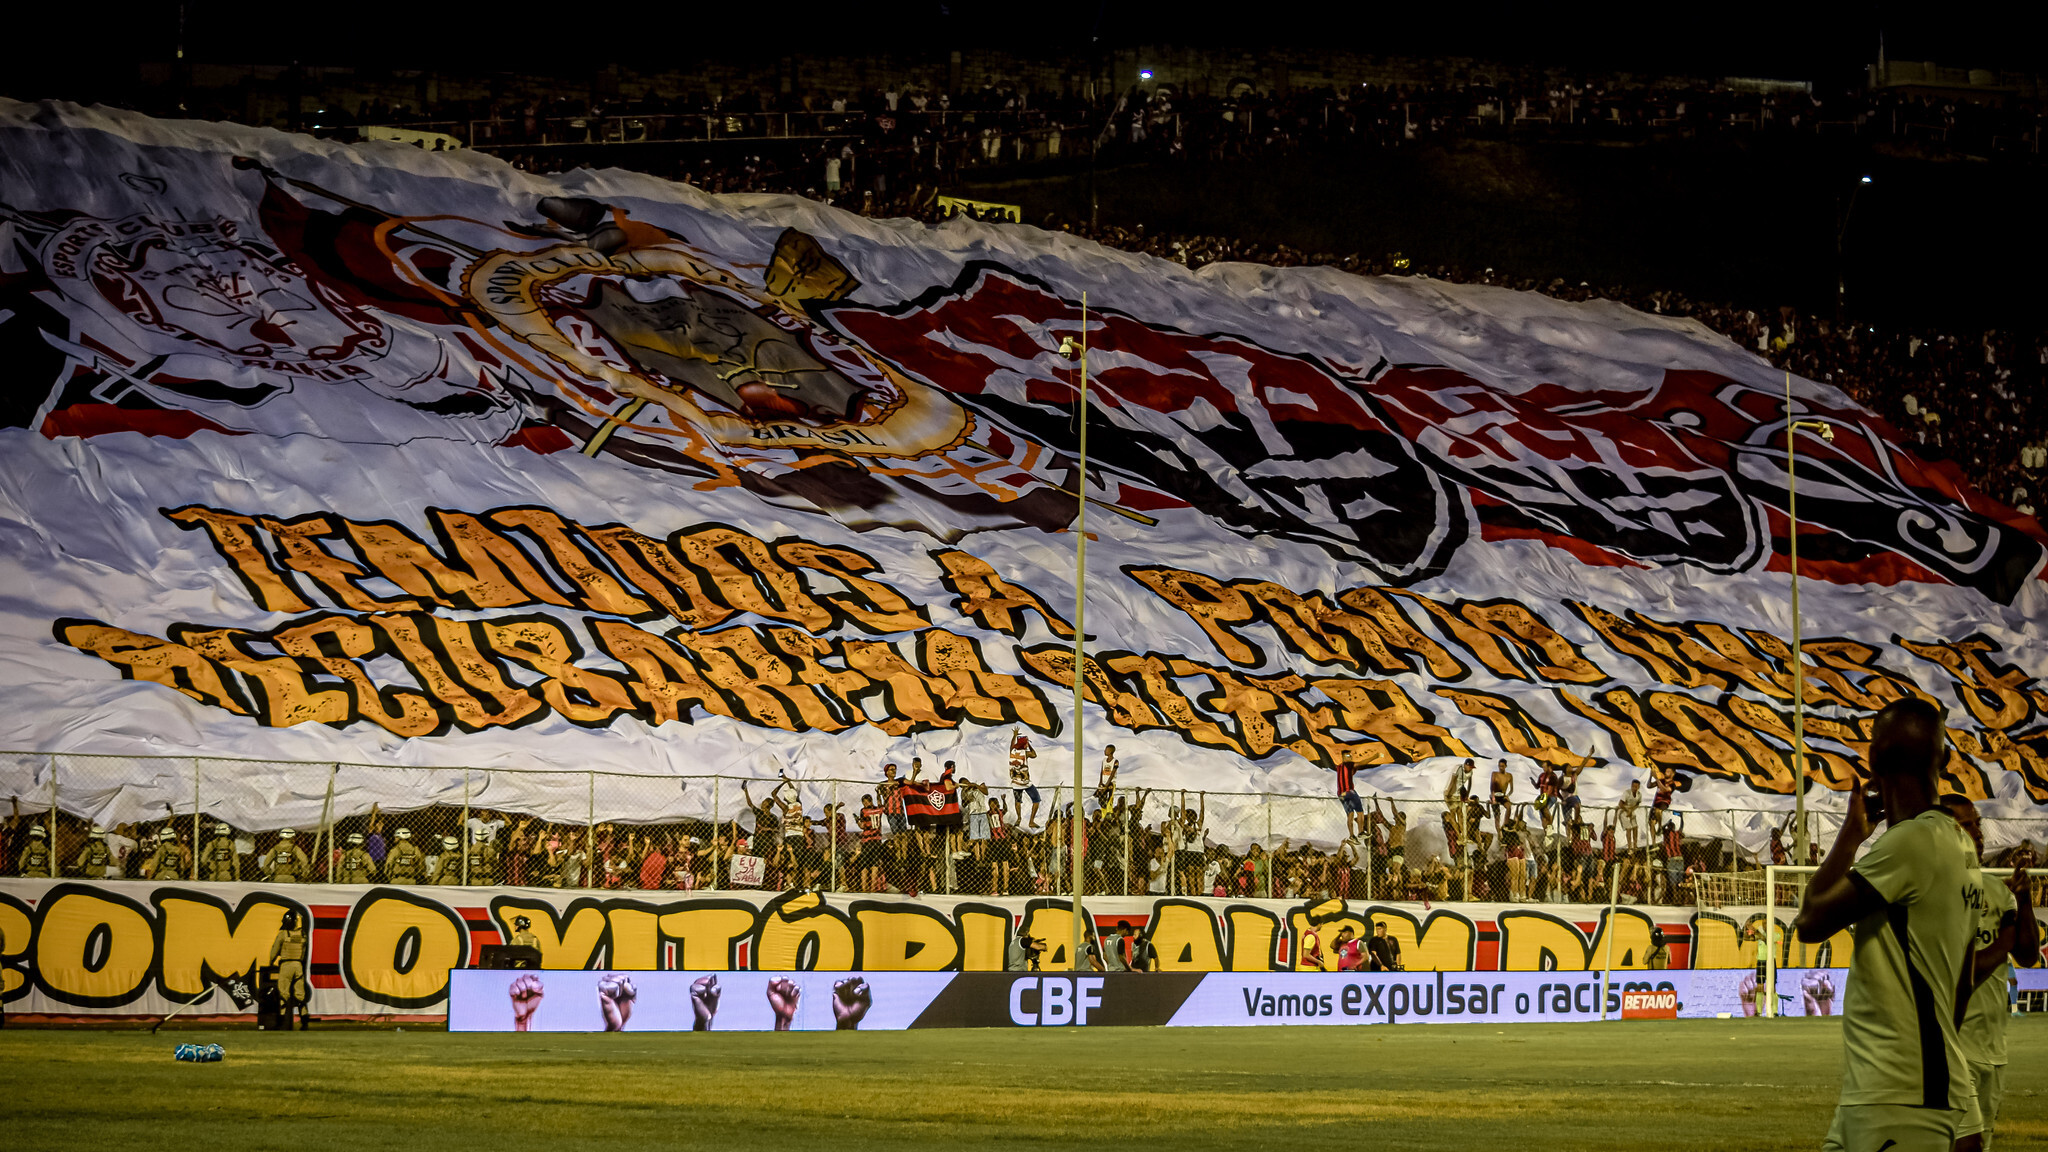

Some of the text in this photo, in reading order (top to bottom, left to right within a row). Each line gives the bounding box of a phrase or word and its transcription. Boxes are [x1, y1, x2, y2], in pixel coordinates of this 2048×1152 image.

[751, 423, 888, 448] BRASIL
[158, 504, 932, 635] TEMIDOS
[926, 544, 1096, 643] A
[343, 887, 470, 1008] O
[1009, 976, 1104, 1027] CBF
[1242, 987, 1333, 1018] Vamos
[1341, 971, 1505, 1025] expulsar
[1515, 992, 1530, 1014] o
[1624, 993, 1676, 1011] BETANO
